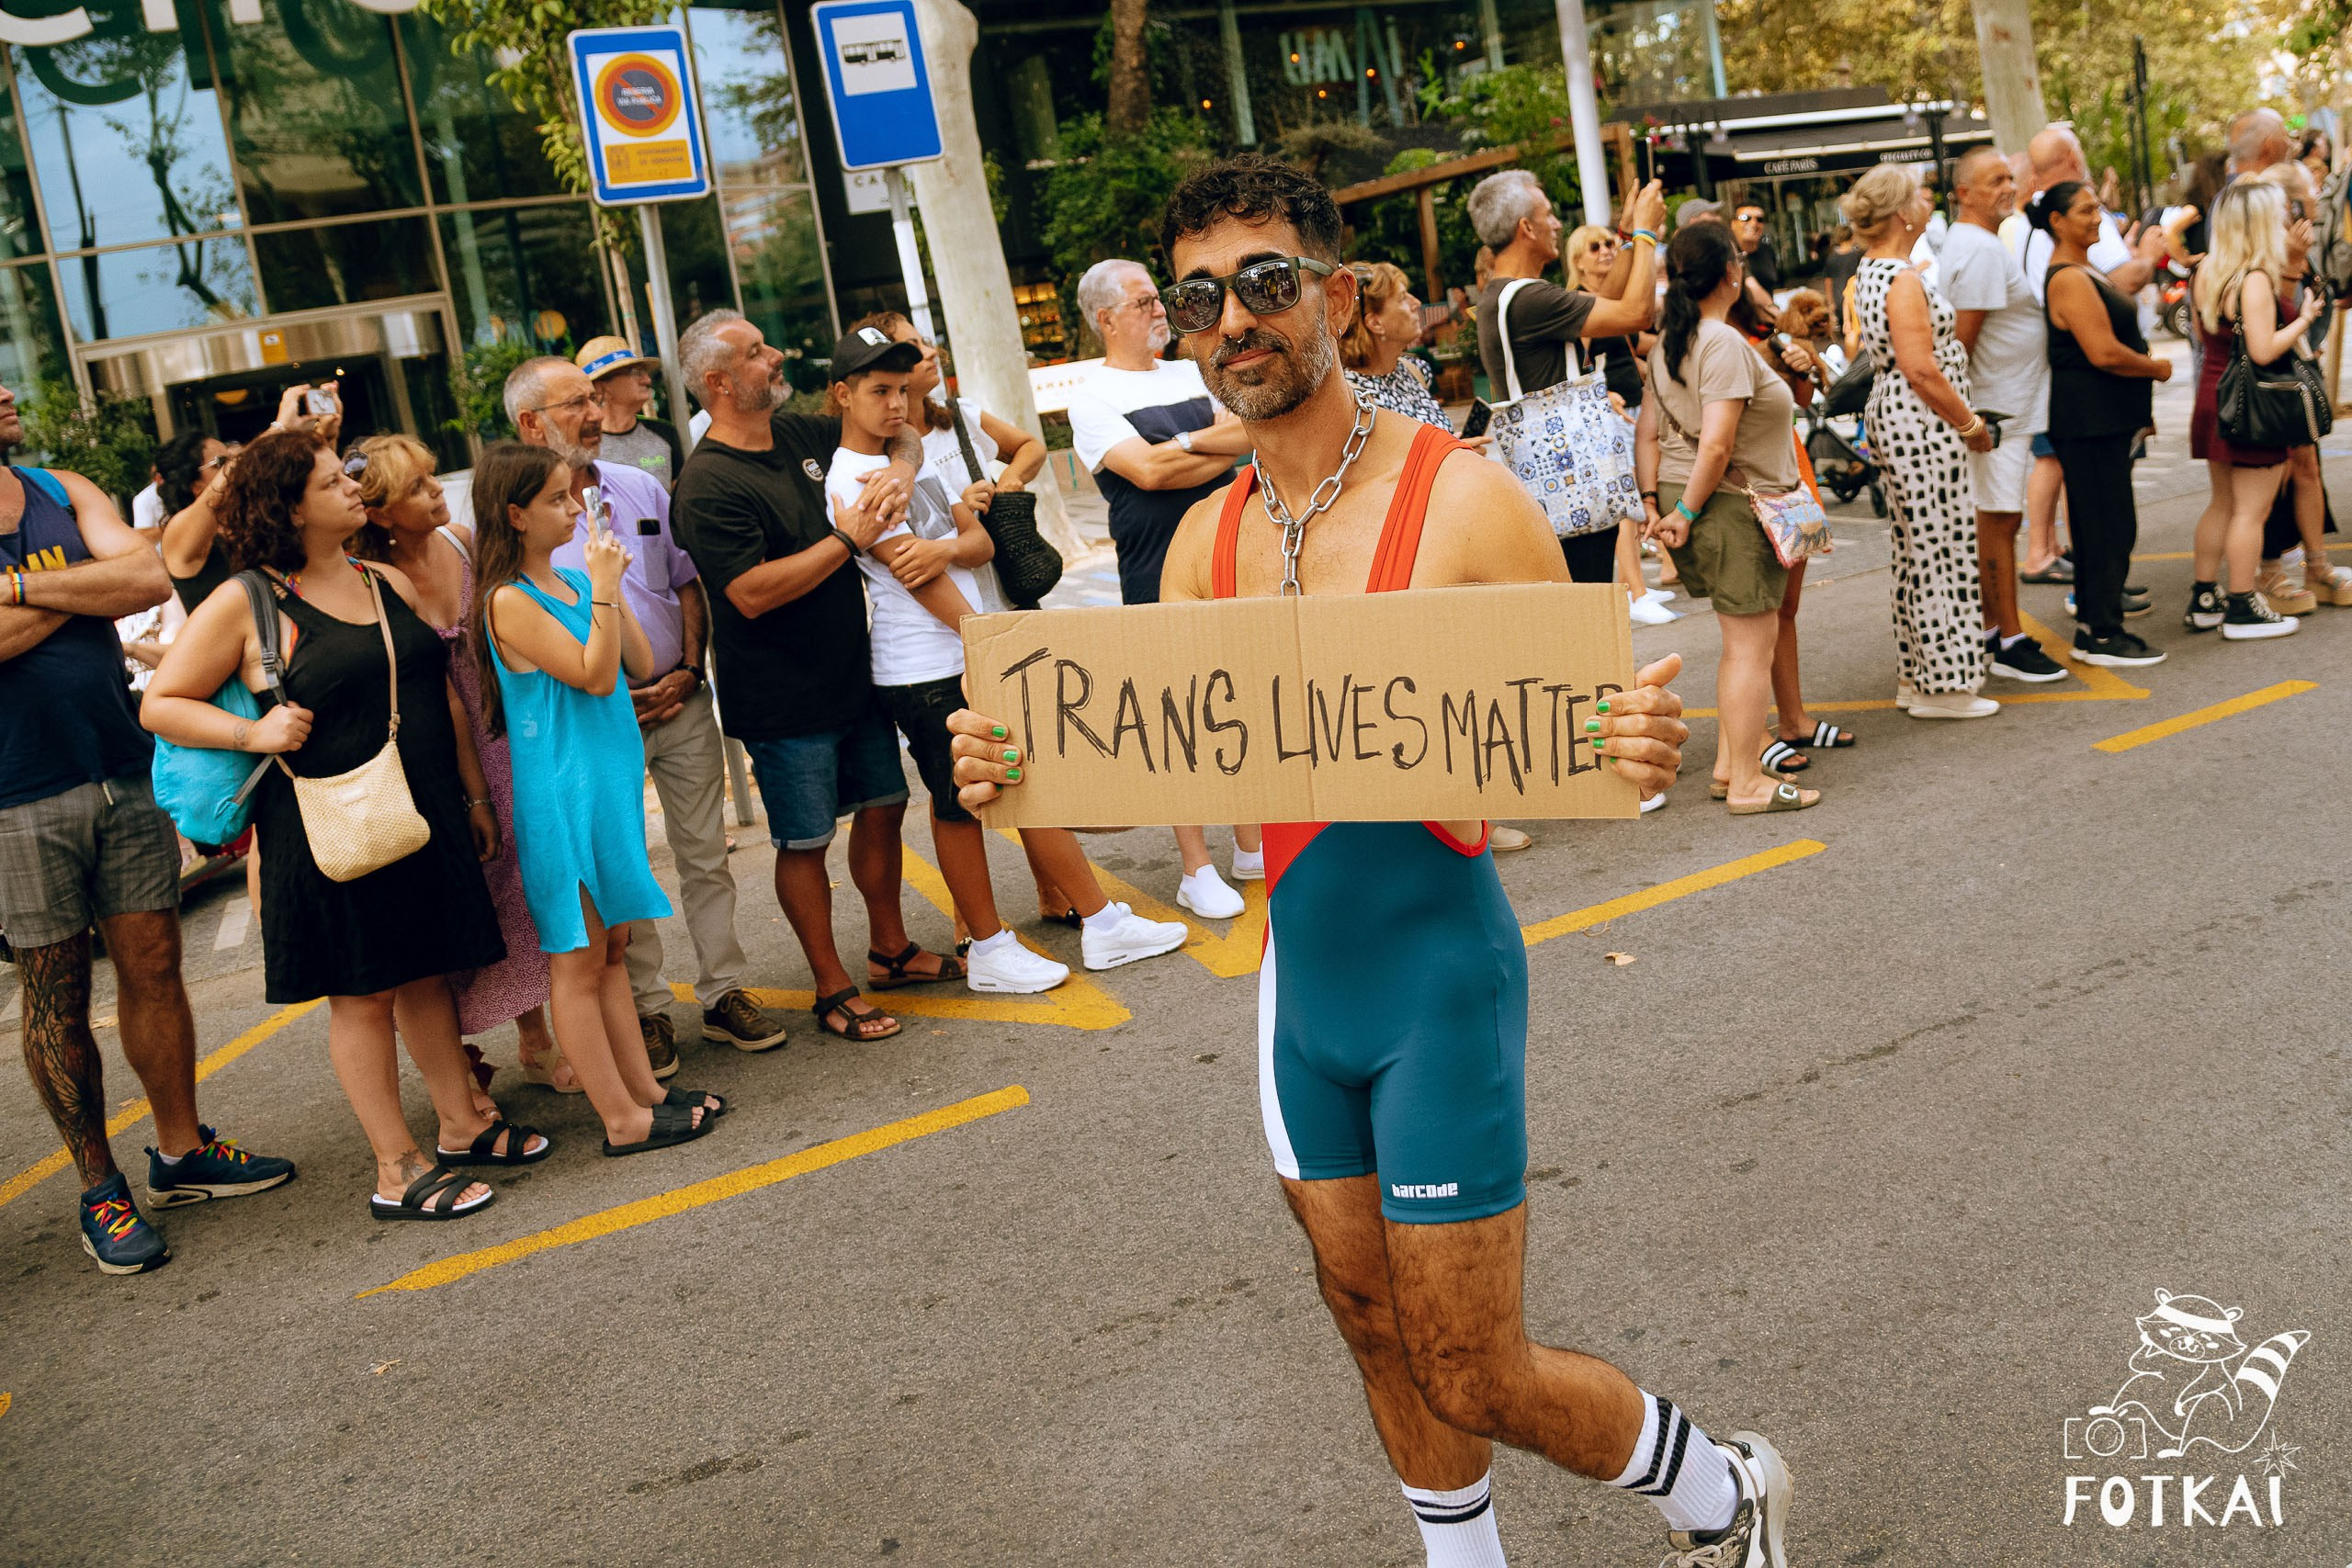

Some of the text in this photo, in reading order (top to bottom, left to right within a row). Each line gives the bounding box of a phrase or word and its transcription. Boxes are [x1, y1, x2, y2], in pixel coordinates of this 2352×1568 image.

[1000, 647, 1248, 776] TRANS
[1272, 673, 1427, 771] LIVES
[1391, 1182, 1459, 1199] barcode
